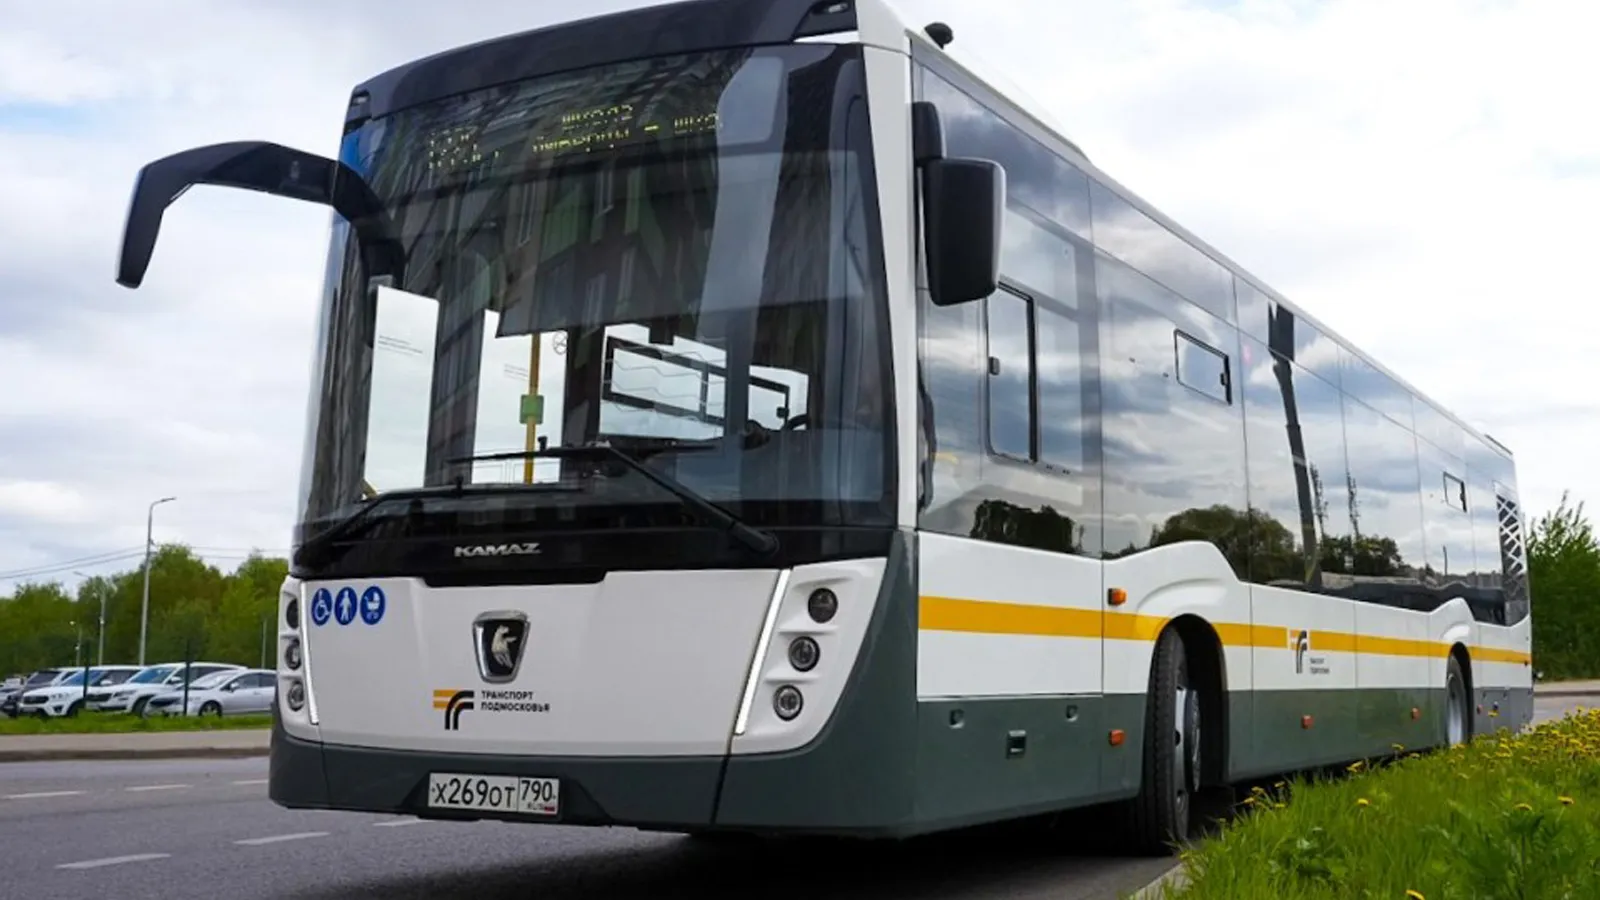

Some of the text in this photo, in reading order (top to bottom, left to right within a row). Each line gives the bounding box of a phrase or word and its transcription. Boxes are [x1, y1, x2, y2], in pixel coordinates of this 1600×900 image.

[454, 542, 541, 557] KAMAZ
[481, 690, 533, 700] ТРАНСПОРТ
[481, 702, 550, 713] ПОДМОСКОВЬЯ
[521, 779, 553, 802] 790
